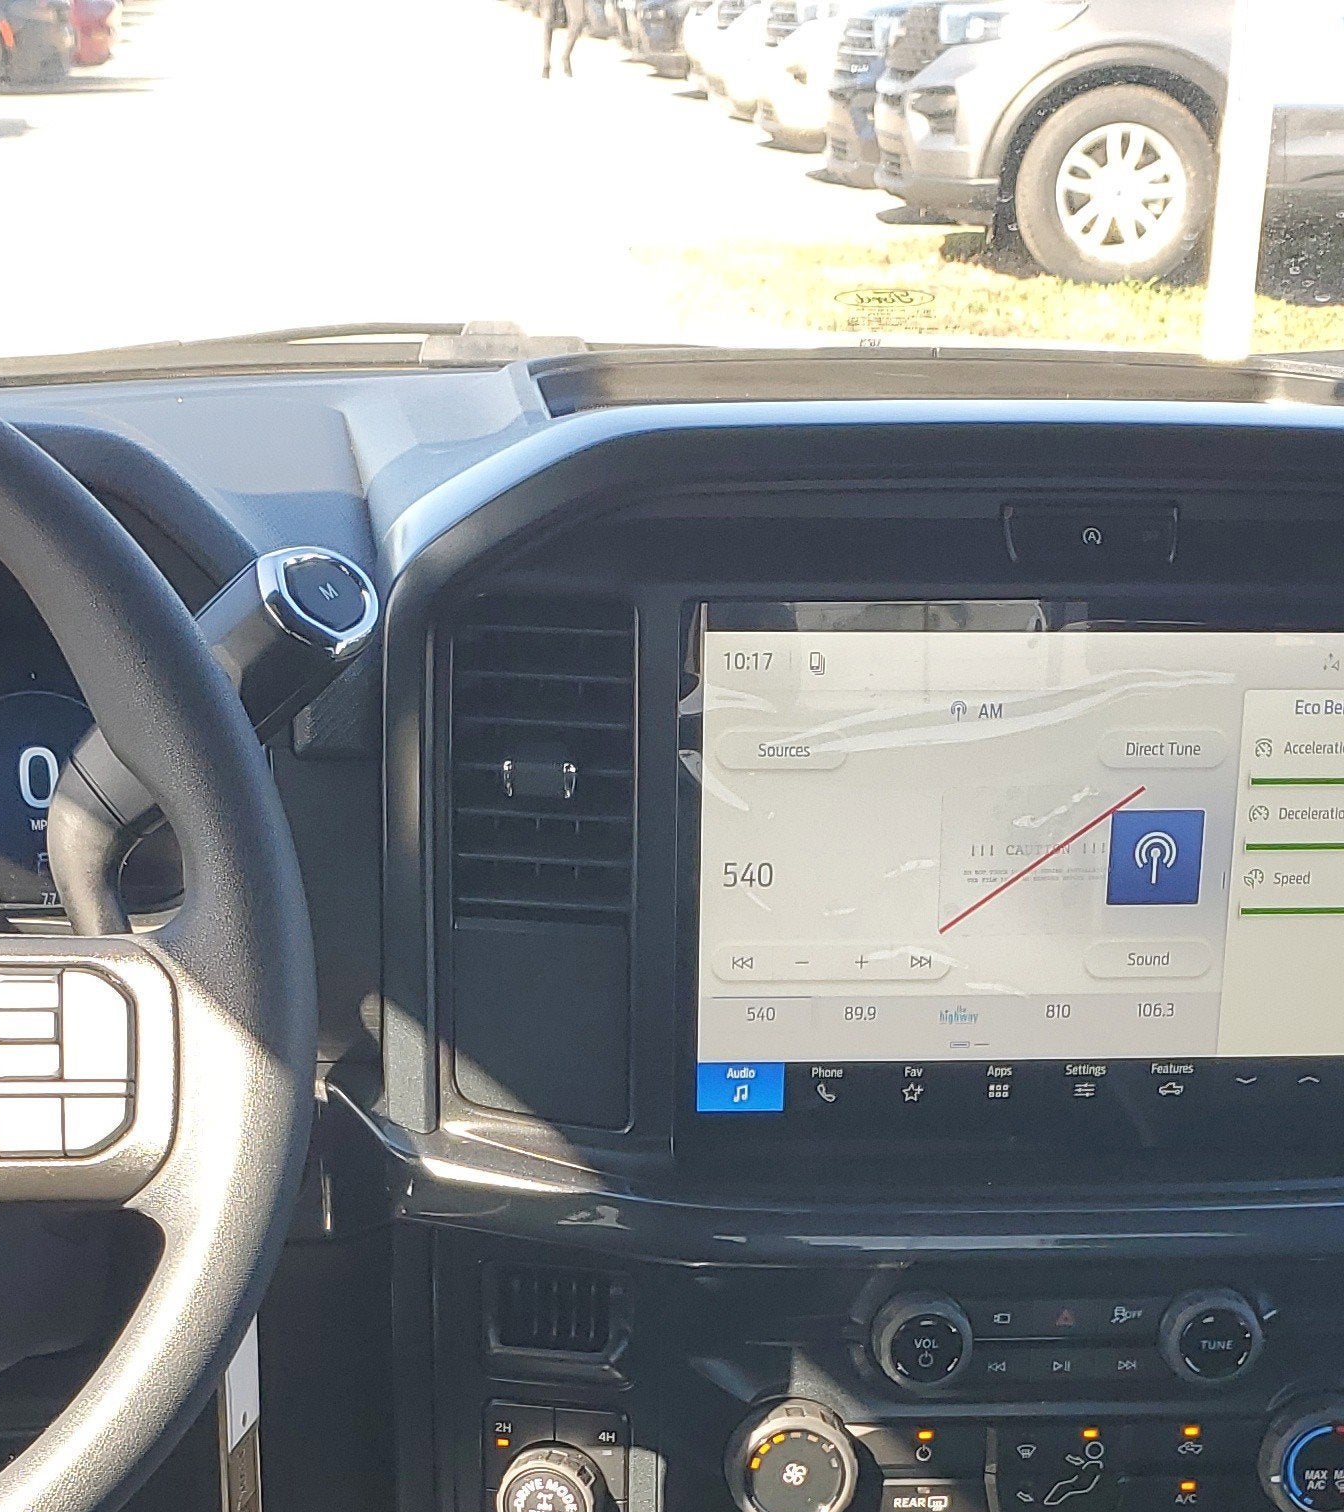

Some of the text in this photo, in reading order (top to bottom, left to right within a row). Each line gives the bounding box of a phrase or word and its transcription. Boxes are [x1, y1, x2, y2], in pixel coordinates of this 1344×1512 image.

[318, 582, 339, 601] M
[722, 652, 773, 671] 10:17
[977, 703, 1004, 719] AM
[1294, 699, 1321, 716] Eco
[757, 742, 811, 759] Sources
[1125, 741, 1201, 756] Direct Tune
[18, 746, 60, 809] 0
[30, 818, 48, 832] MP
[722, 861, 775, 889] 540
[1272, 871, 1312, 887] Speed
[1126, 952, 1170, 967] Sound
[746, 1006, 776, 1022] 540
[844, 1005, 877, 1021] 89.9
[1045, 1003, 1071, 1019] 810
[1136, 1002, 1175, 1018] 106.3
[726, 1066, 756, 1079] Audio
[811, 1066, 844, 1079] Phone
[904, 1065, 924, 1078] Fav
[986, 1065, 1013, 1078] Apps
[1064, 1063, 1107, 1078] Settings
[1150, 1062, 1195, 1075] Features
[913, 1337, 939, 1349] VOL
[1200, 1339, 1235, 1351] TUNE
[494, 1422, 513, 1434] 2H
[597, 1431, 617, 1444] 4H
[1304, 1469, 1328, 1481] MAX
[1306, 1480, 1327, 1491] A/C
[513, 1477, 578, 1512] DRIVE MODE
[1174, 1493, 1198, 1505] A/C
[892, 1496, 927, 1510] REAR
